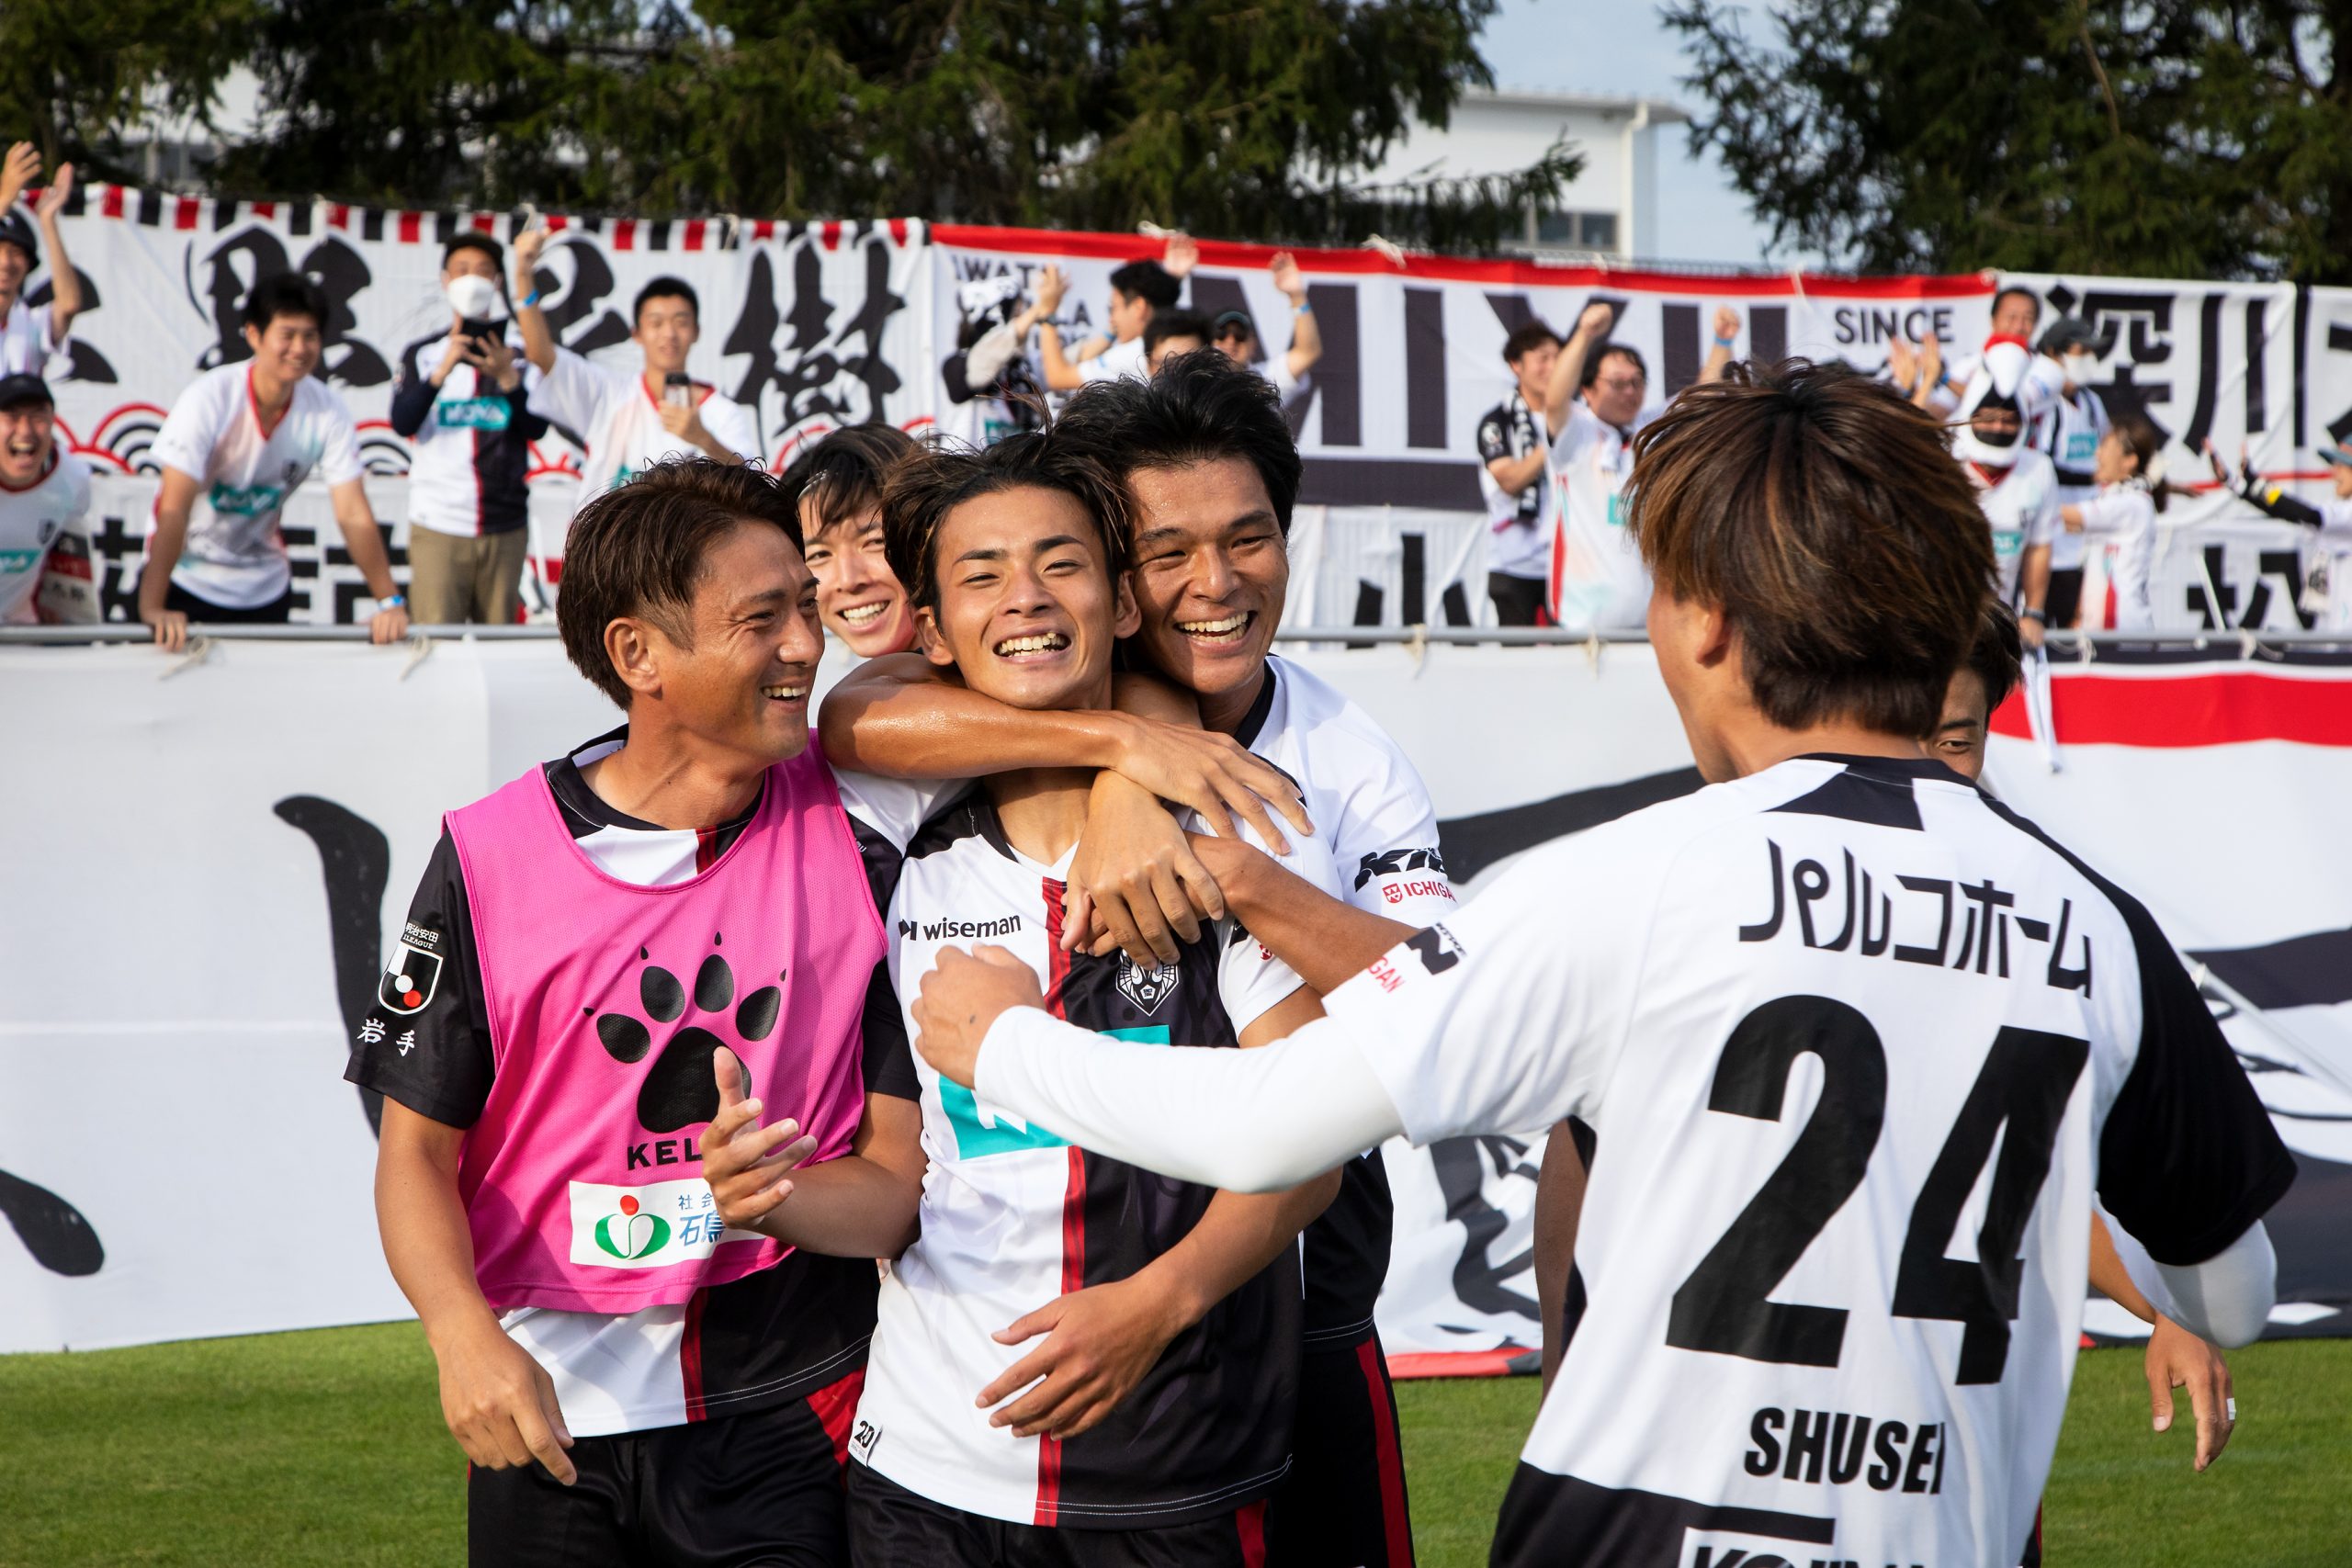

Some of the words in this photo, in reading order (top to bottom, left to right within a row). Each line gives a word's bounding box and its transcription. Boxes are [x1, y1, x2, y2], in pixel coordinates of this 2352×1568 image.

[1835, 307, 1955, 344] SINCE
[1403, 880, 1458, 904] ICHIGA
[922, 915, 1022, 941] wiseman
[1738, 836, 2092, 1000] パルコホーム
[356, 1018, 415, 1057] 岩手
[627, 1137, 703, 1171] KEL
[678, 1191, 713, 1211] 社会
[1666, 994, 2090, 1387] 24
[679, 1209, 726, 1247] 石鳥
[1744, 1407, 1946, 1495] SHUSEI
